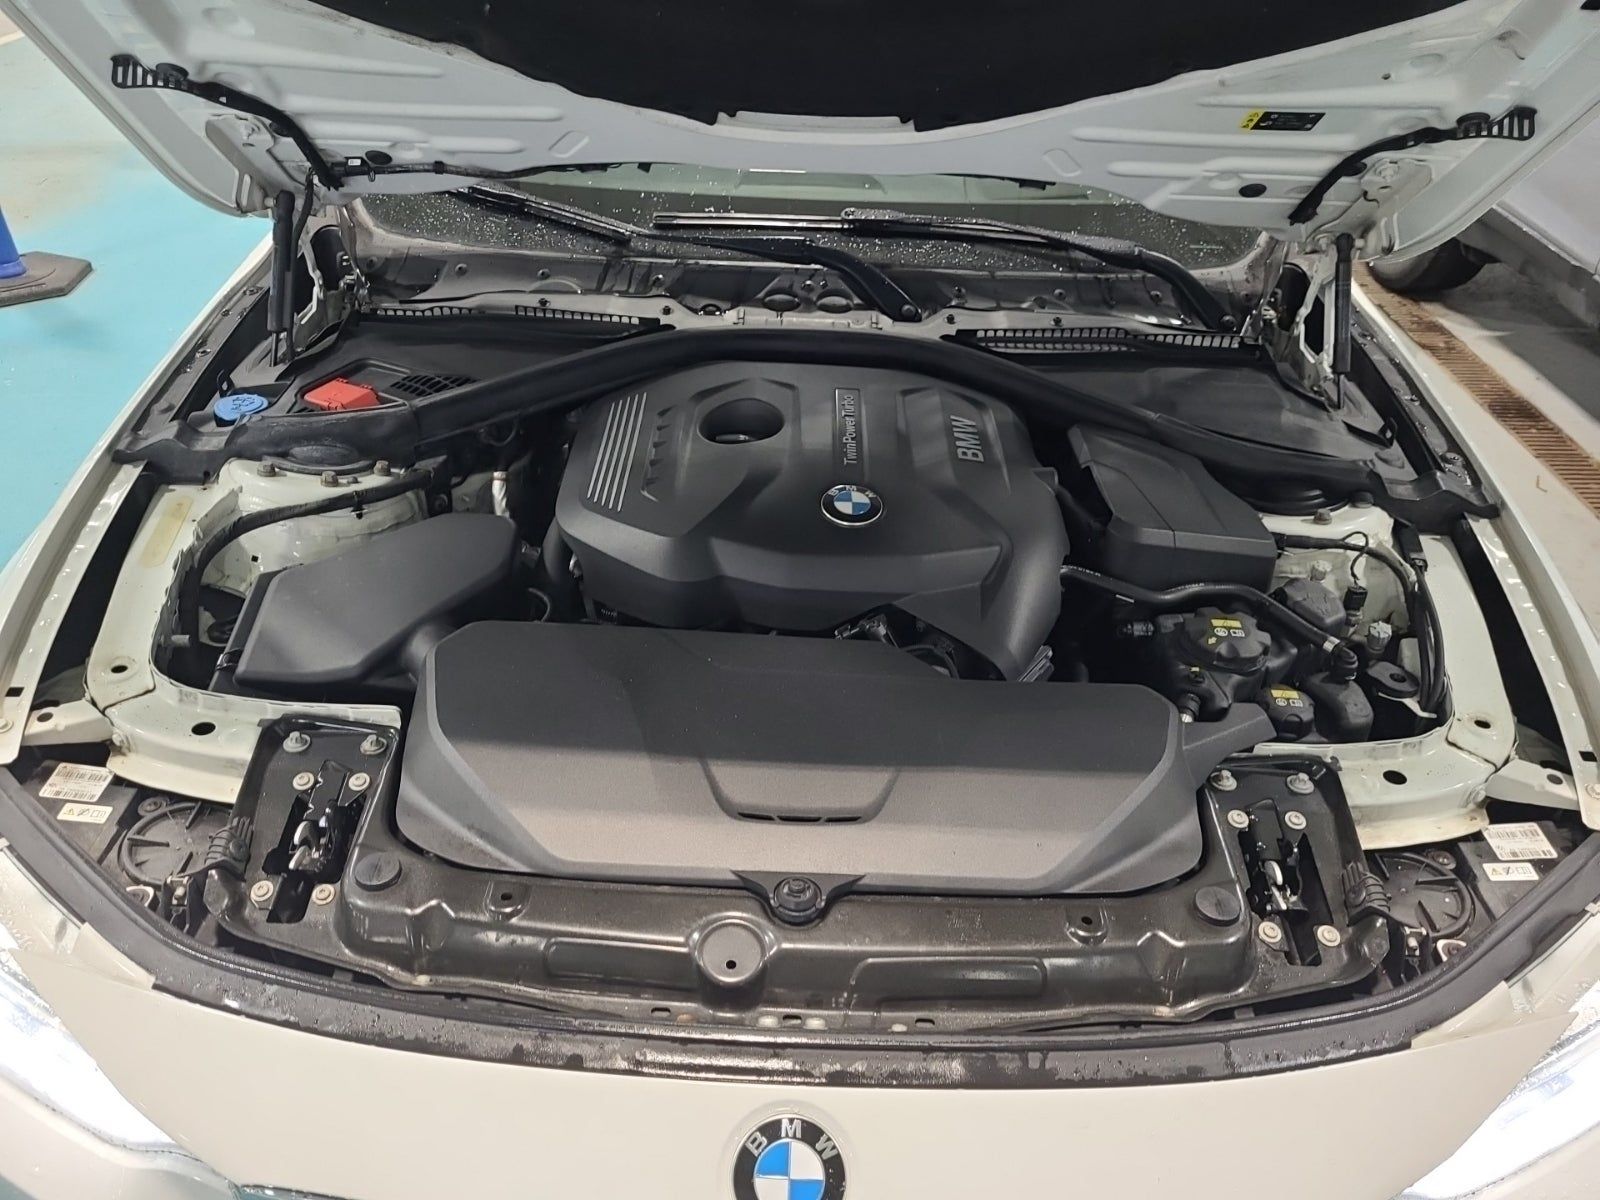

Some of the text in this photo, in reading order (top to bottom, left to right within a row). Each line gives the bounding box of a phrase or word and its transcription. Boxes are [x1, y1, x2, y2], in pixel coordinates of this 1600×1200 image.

[841, 394, 856, 417] Turbo
[950, 415, 984, 463] BMW
[828, 485, 878, 498] BMW
[744, 1118, 839, 1161] BMW
